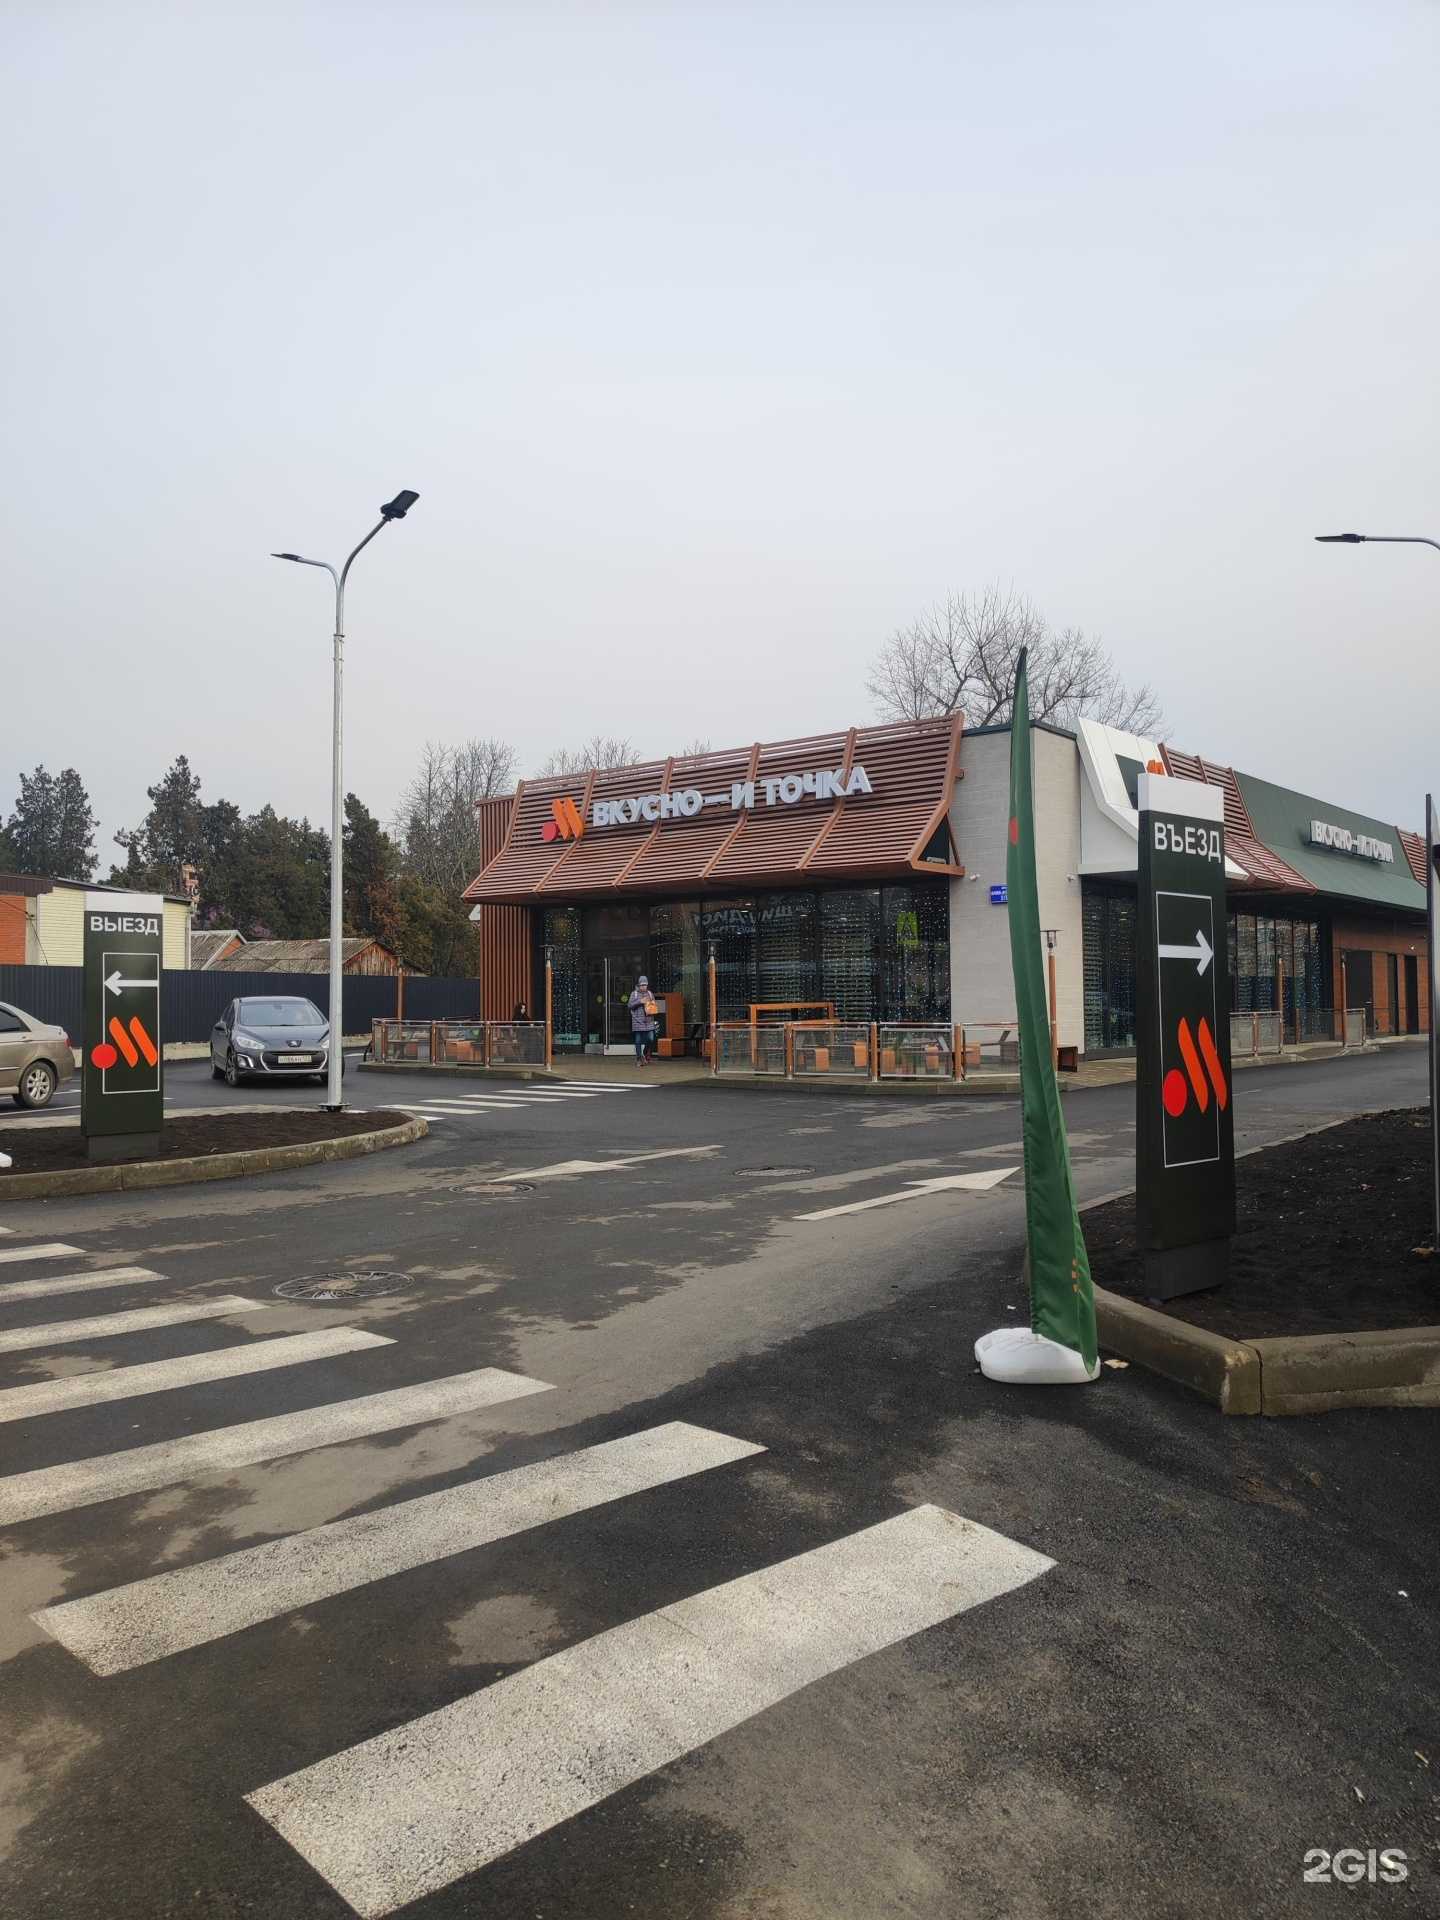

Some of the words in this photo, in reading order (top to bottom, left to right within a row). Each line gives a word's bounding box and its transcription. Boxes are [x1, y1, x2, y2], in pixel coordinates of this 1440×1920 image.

[760, 766, 873, 807] ТОЧКА
[1154, 821, 1222, 863] ВЪЕЗД
[90, 915, 159, 936] ВЫЕЗД
